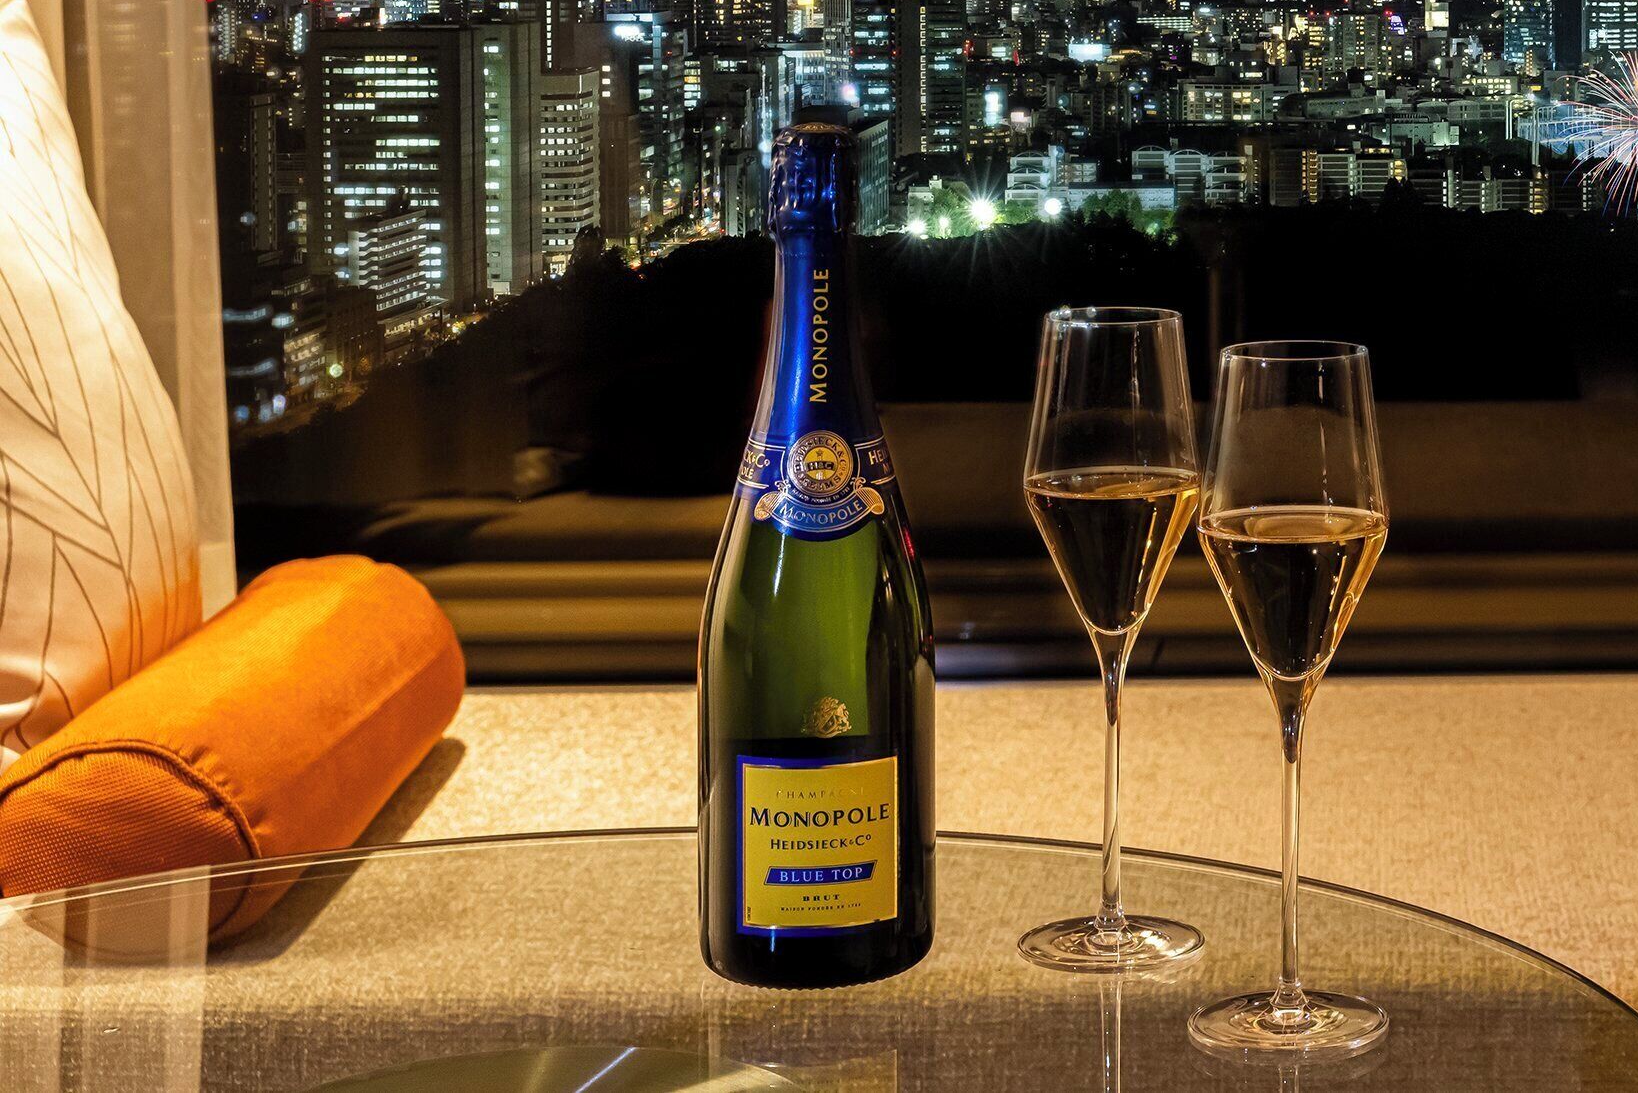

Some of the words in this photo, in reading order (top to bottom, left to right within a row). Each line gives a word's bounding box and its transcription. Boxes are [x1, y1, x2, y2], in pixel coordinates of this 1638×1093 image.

[808, 268, 830, 404] MONOPOLE
[779, 499, 863, 525] MONOPOLE
[749, 803, 890, 828] MONOPOLE
[780, 870, 824, 883] BLUE
[831, 866, 863, 881] TOP
[802, 893, 841, 903] BRUT
